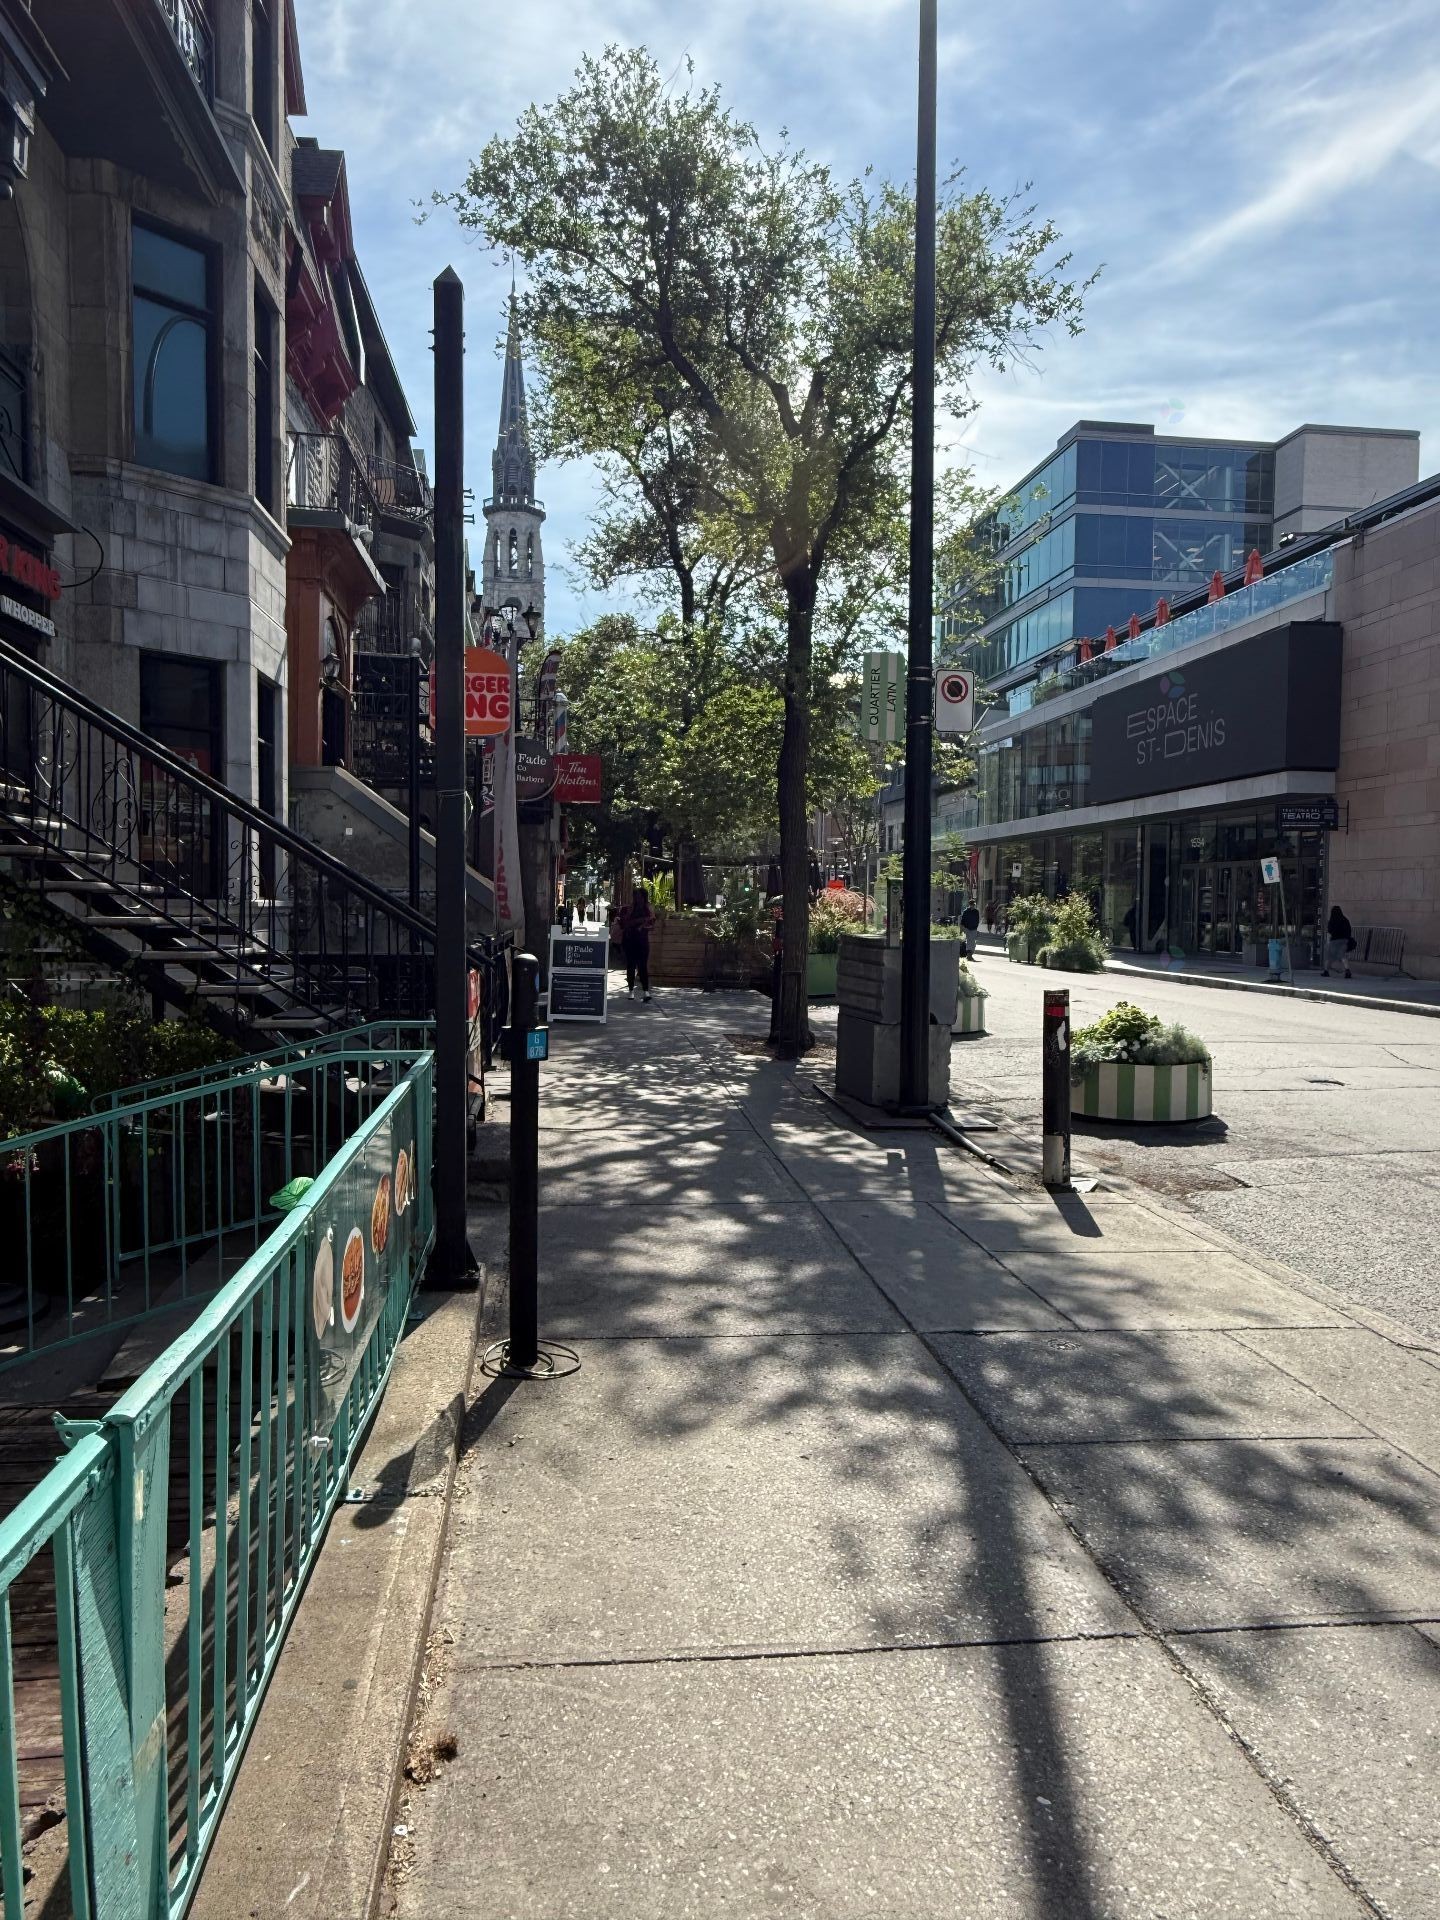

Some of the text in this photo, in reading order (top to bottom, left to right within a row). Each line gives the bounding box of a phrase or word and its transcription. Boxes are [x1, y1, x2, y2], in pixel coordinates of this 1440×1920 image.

[13, 543, 62, 601] KING
[1, 594, 56, 637] WHOPPER
[869, 667, 881, 726] QUARTIER
[885, 681, 897, 712] LATIN
[1126, 692, 1198, 739] ESPACE
[518, 753, 547, 765] Fade
[568, 761, 587, 773] Tim
[1281, 812, 1320, 820] TEATRO
[534, 1033, 540, 1044] G
